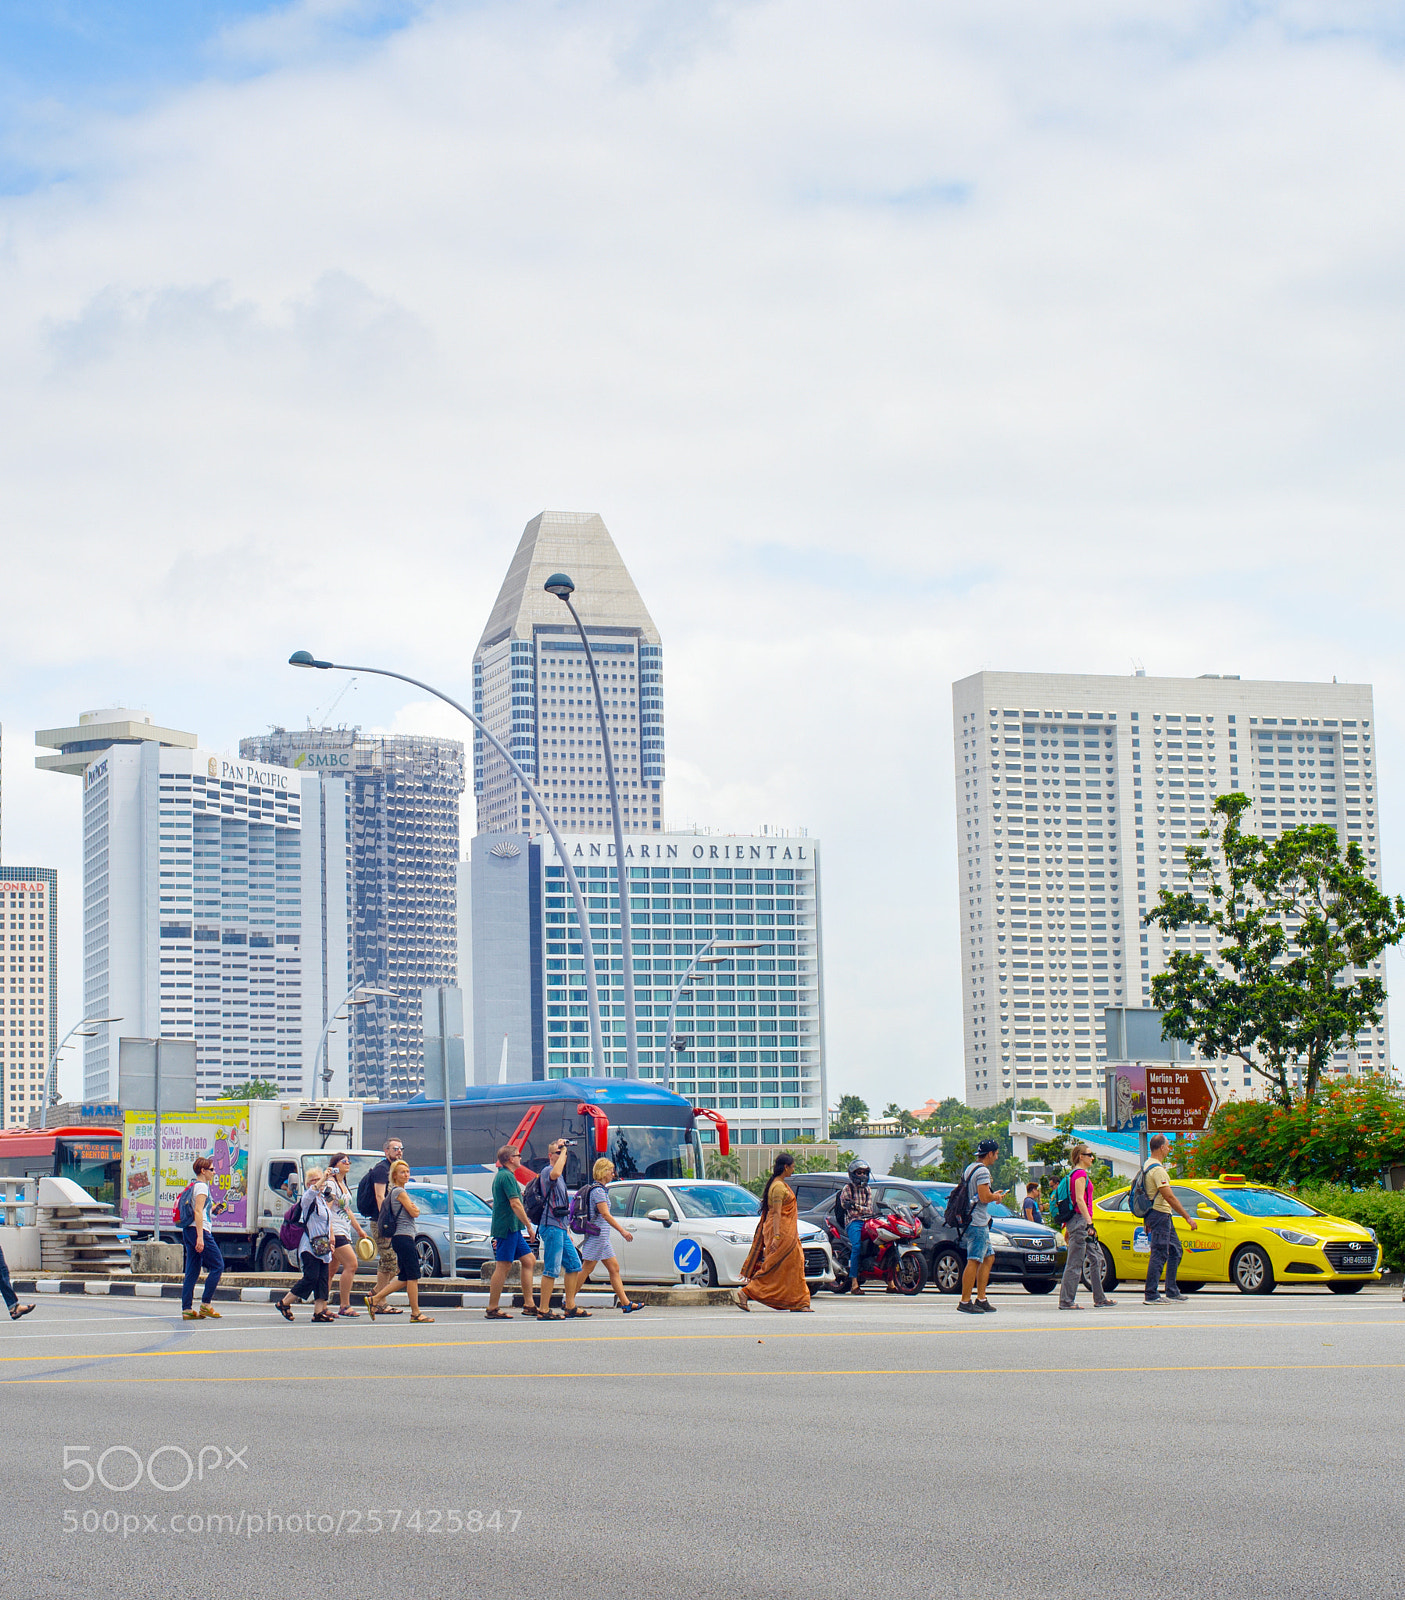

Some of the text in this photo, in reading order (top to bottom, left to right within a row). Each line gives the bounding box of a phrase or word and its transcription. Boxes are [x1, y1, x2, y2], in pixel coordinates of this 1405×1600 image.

[307, 753, 350, 767] SMBC
[222, 761, 288, 788] PAN PACIFIC
[692, 844, 807, 860] ORIENTAL
[1149, 1072, 1189, 1084] Merlion Park
[1167, 1096, 1185, 1105] Merlion
[81, 1105, 122, 1116] MARI
[128, 1136, 208, 1151] Japanes Sweet Potato
[81, 1150, 110, 1159] SHENTON
